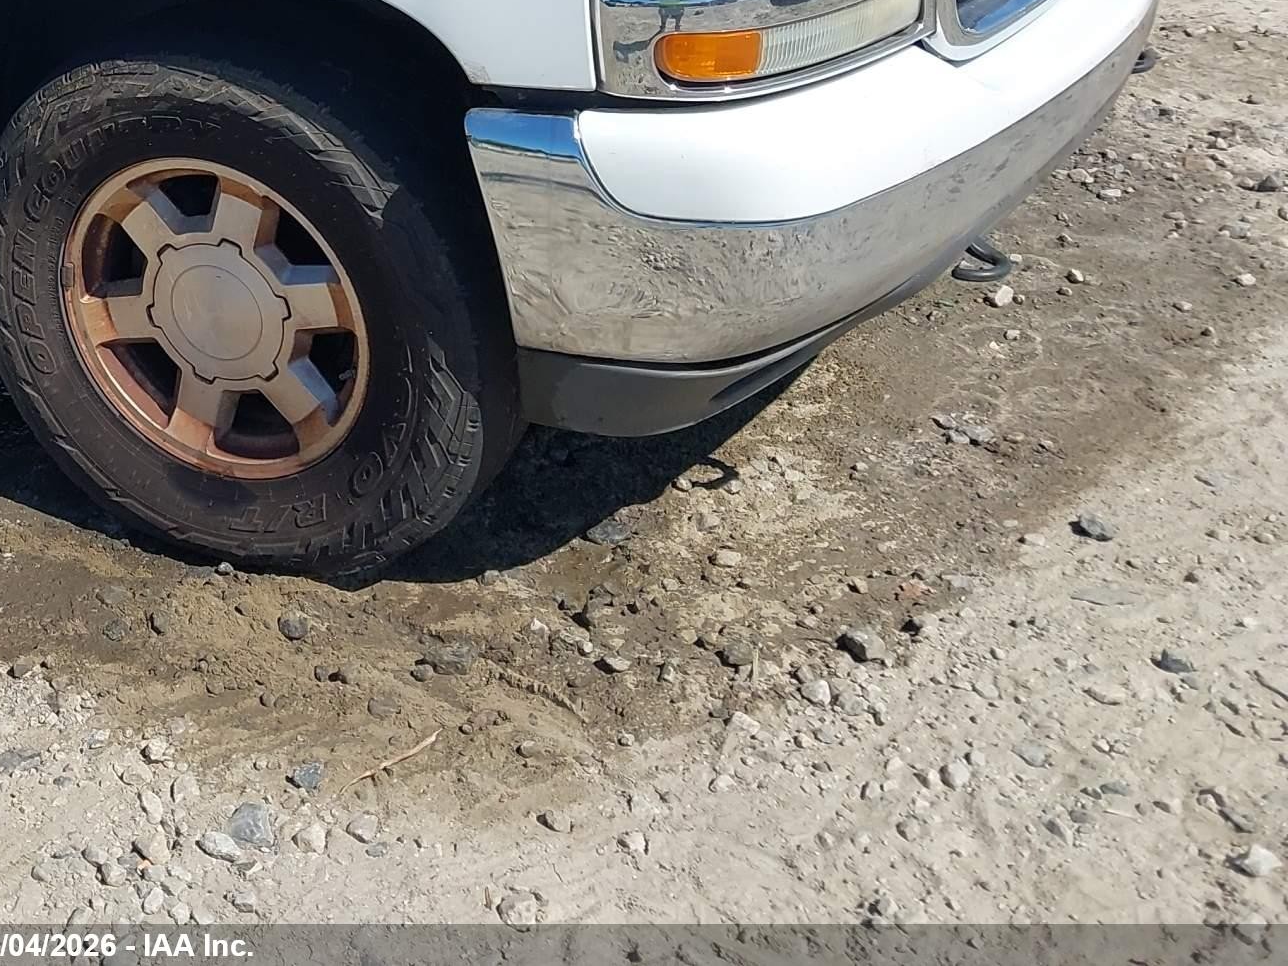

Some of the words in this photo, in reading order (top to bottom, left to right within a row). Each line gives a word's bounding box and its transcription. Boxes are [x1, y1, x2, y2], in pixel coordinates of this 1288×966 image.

[23, 113, 224, 226] COUN
[12, 227, 57, 375] OPEN
[224, 492, 328, 534] R/T
